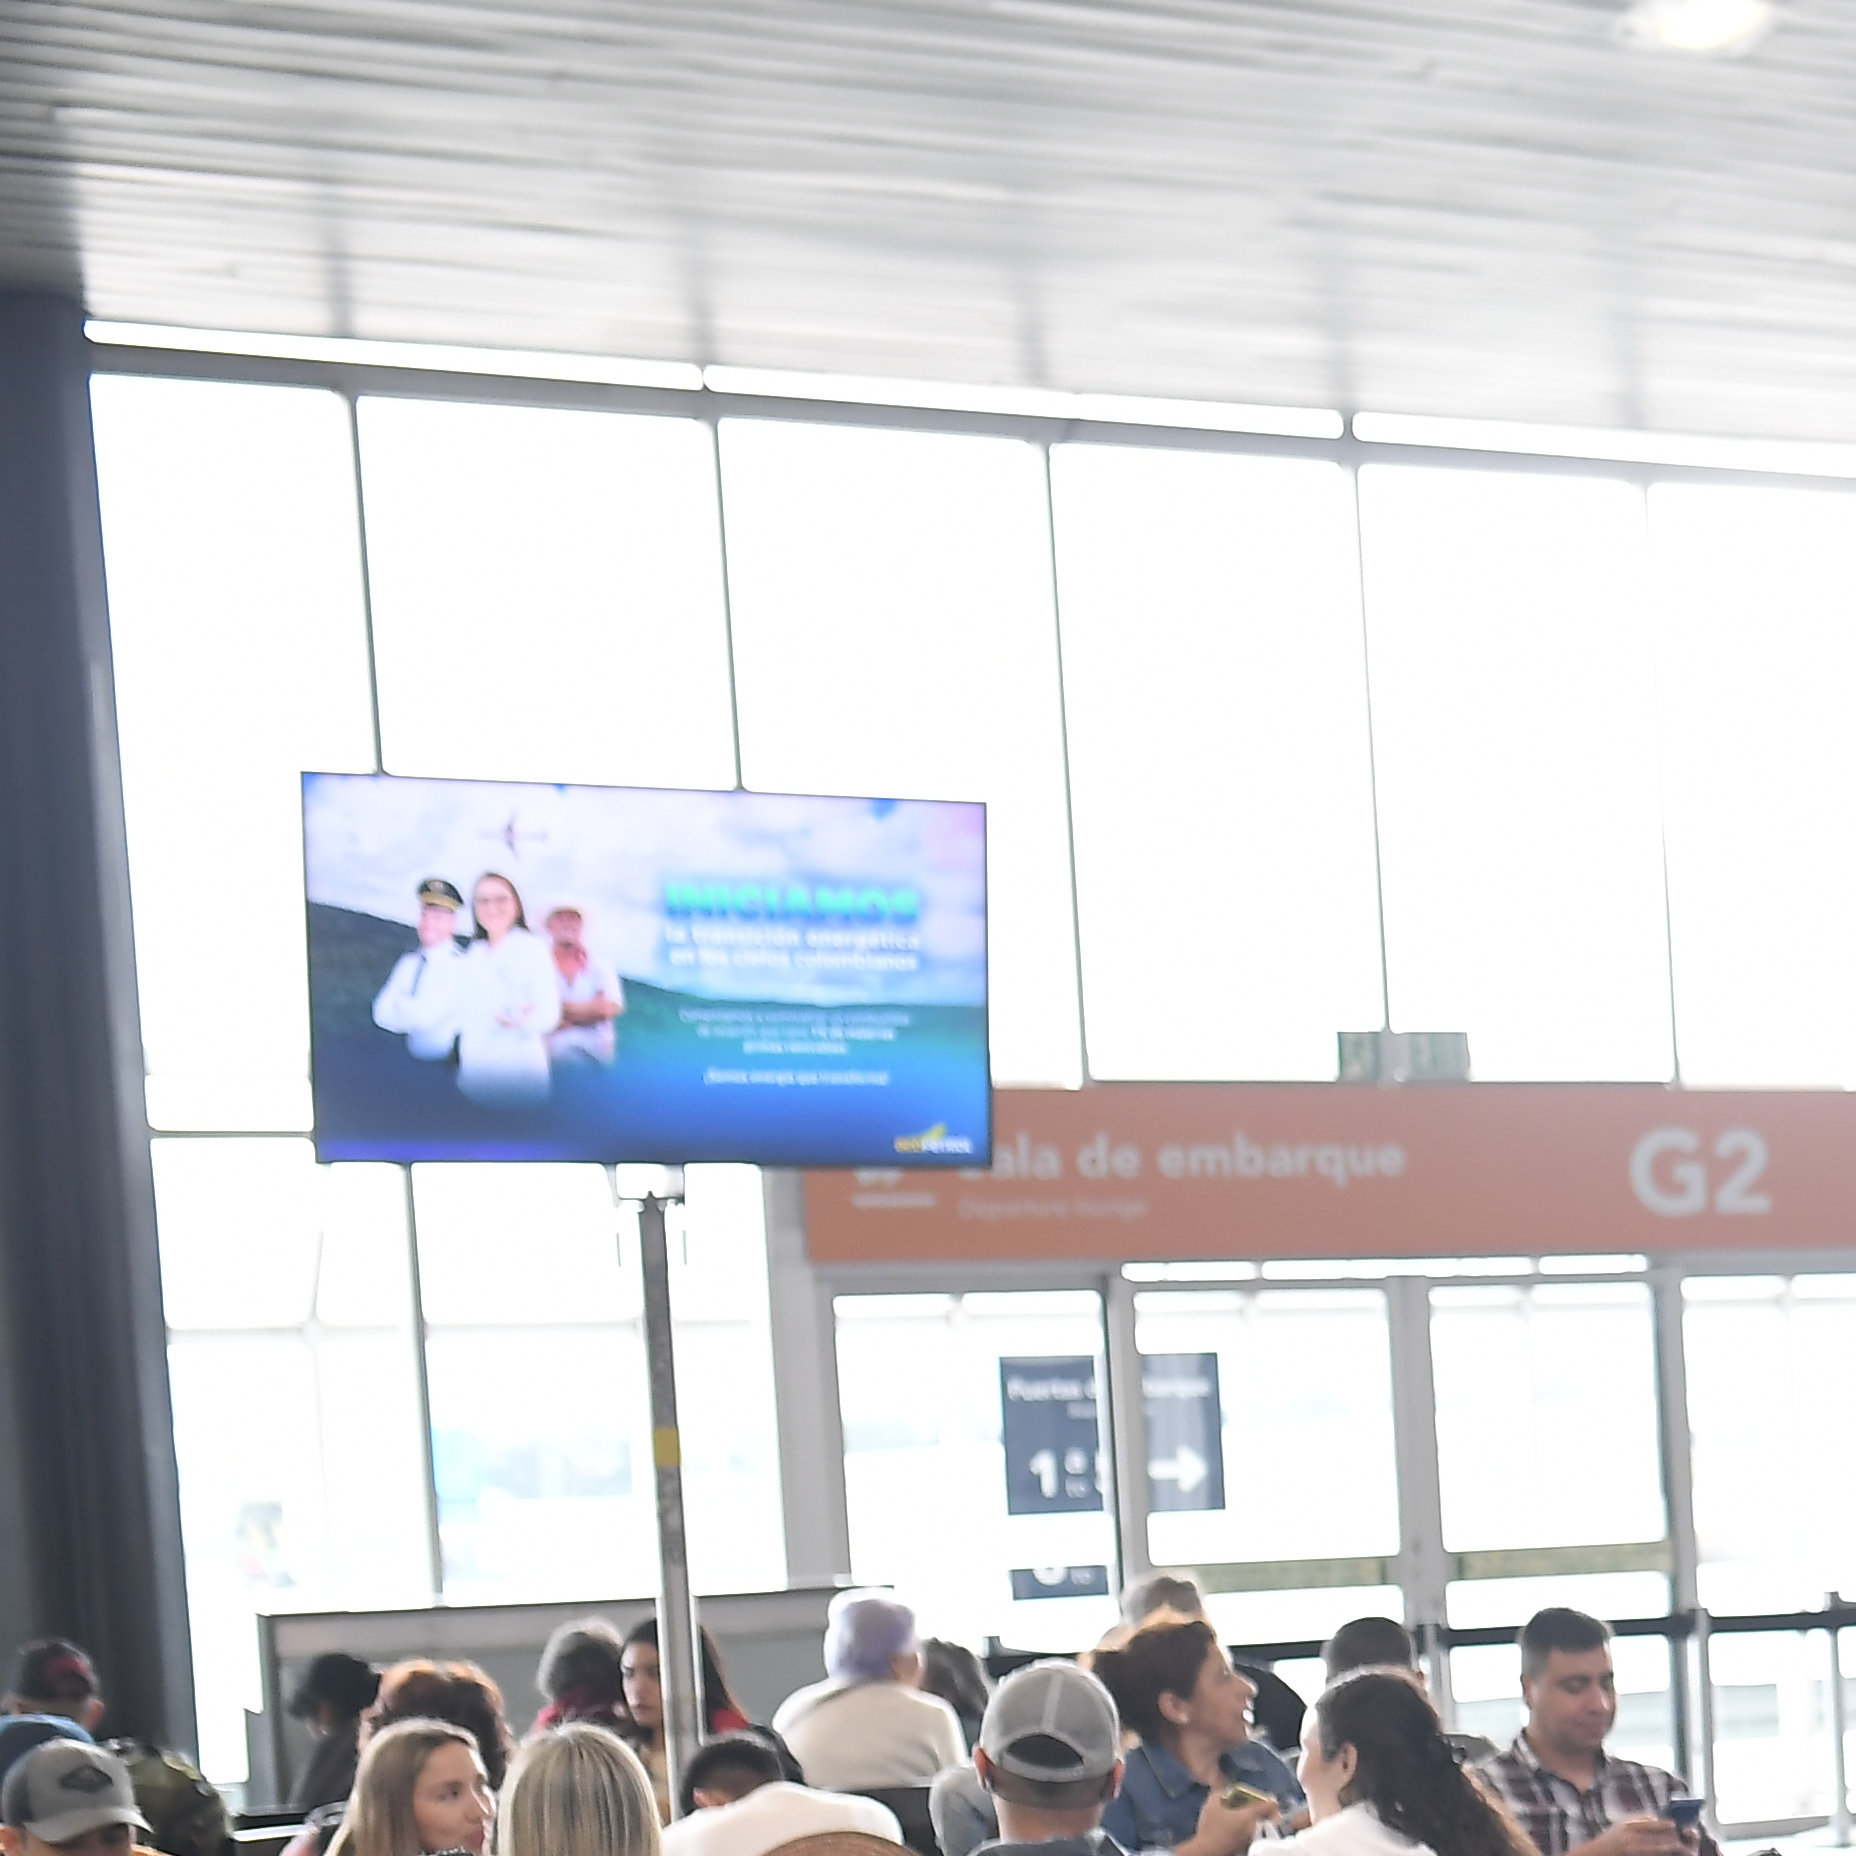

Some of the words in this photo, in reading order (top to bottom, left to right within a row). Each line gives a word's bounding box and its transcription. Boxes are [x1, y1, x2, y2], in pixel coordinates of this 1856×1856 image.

[959, 1130, 1062, 1180] ala
[1076, 1130, 1142, 1180] de
[1156, 1130, 1406, 1190] embarque
[1631, 1127, 1771, 1217] G2
[1028, 1449, 1058, 1499] 1
